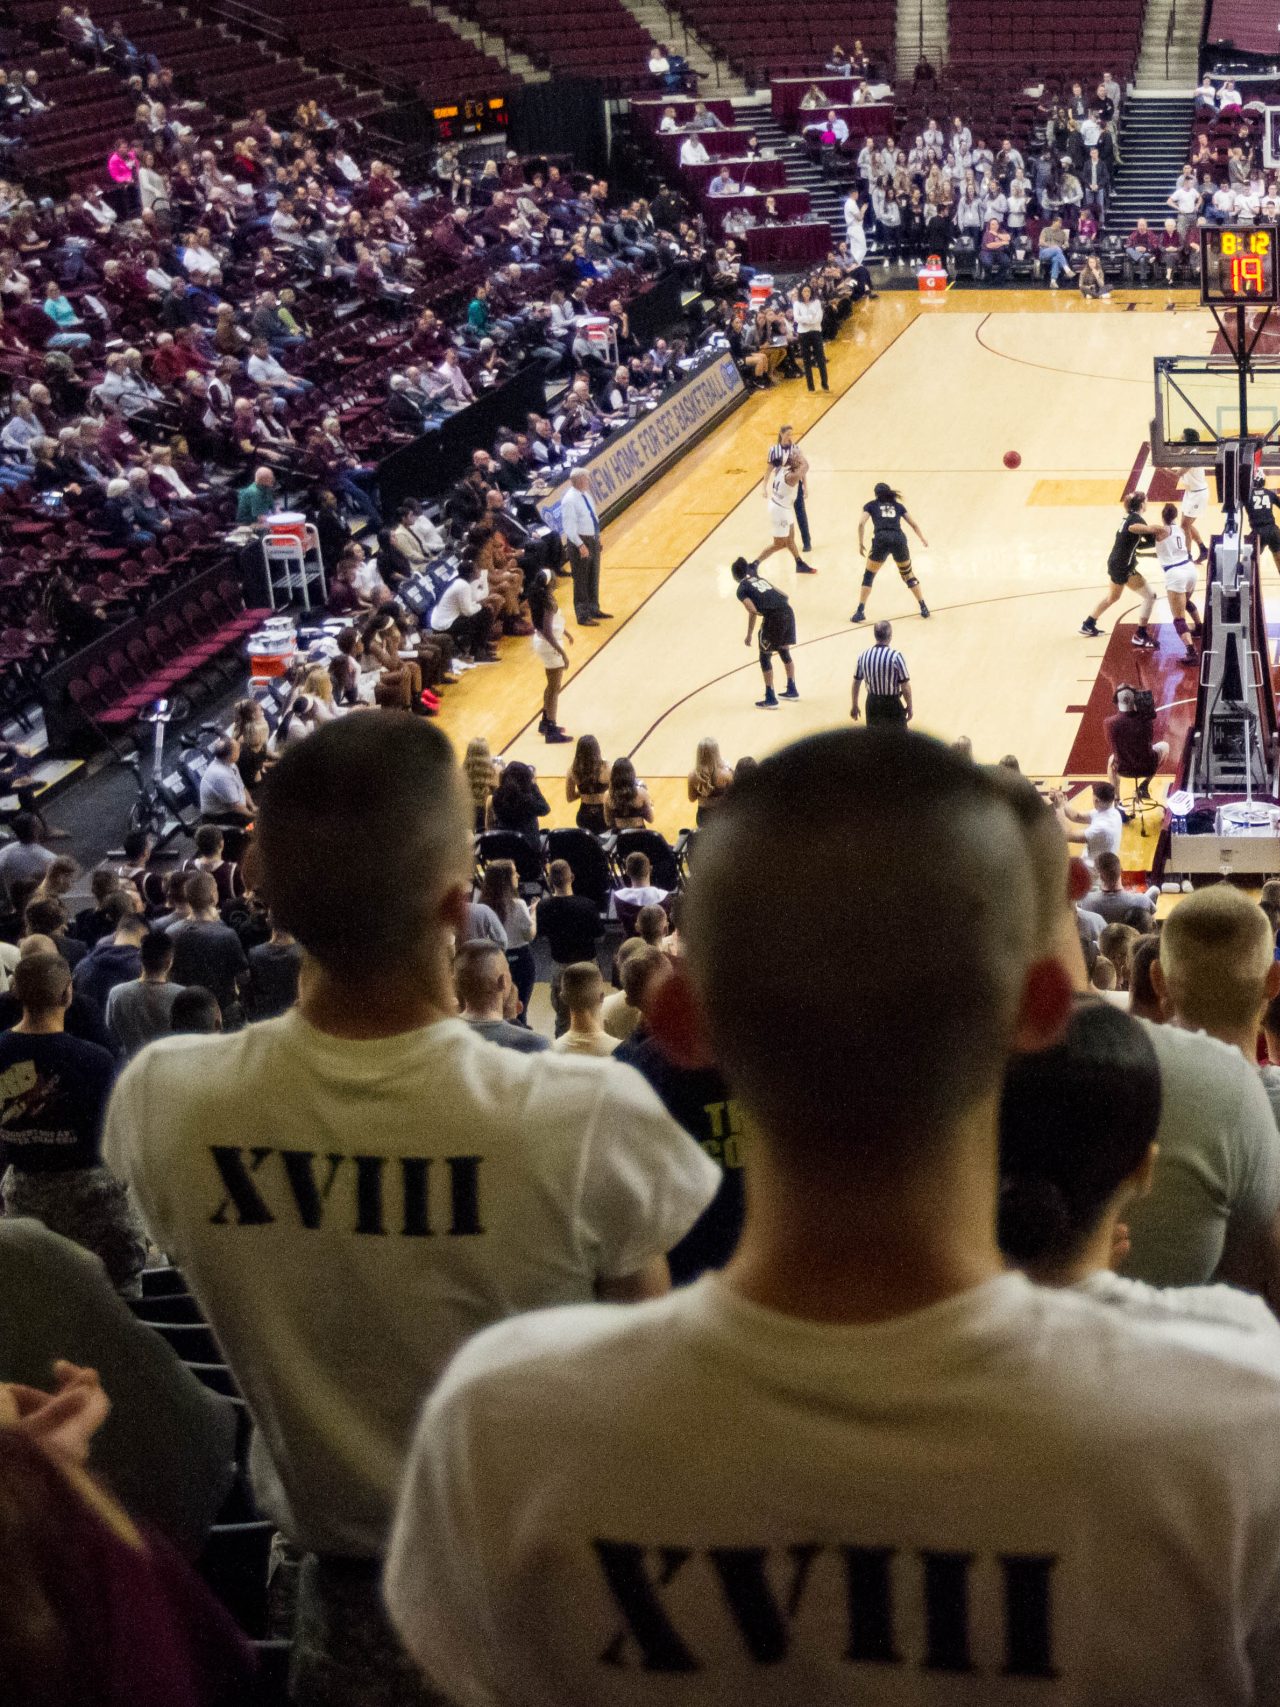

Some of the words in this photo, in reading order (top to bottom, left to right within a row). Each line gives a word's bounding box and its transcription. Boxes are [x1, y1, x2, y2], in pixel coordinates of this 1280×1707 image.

[1221, 231, 1270, 255] 8:12
[1231, 257, 1264, 293] 19
[609, 438, 645, 487] HOME
[637, 422, 663, 460] FOR
[655, 409, 681, 446] SEC
[673, 372, 727, 432] BASKETBALL
[1252, 495, 1270, 510] 24
[208, 1145, 486, 1236] XVIII
[594, 1538, 1060, 1678] XVIII
